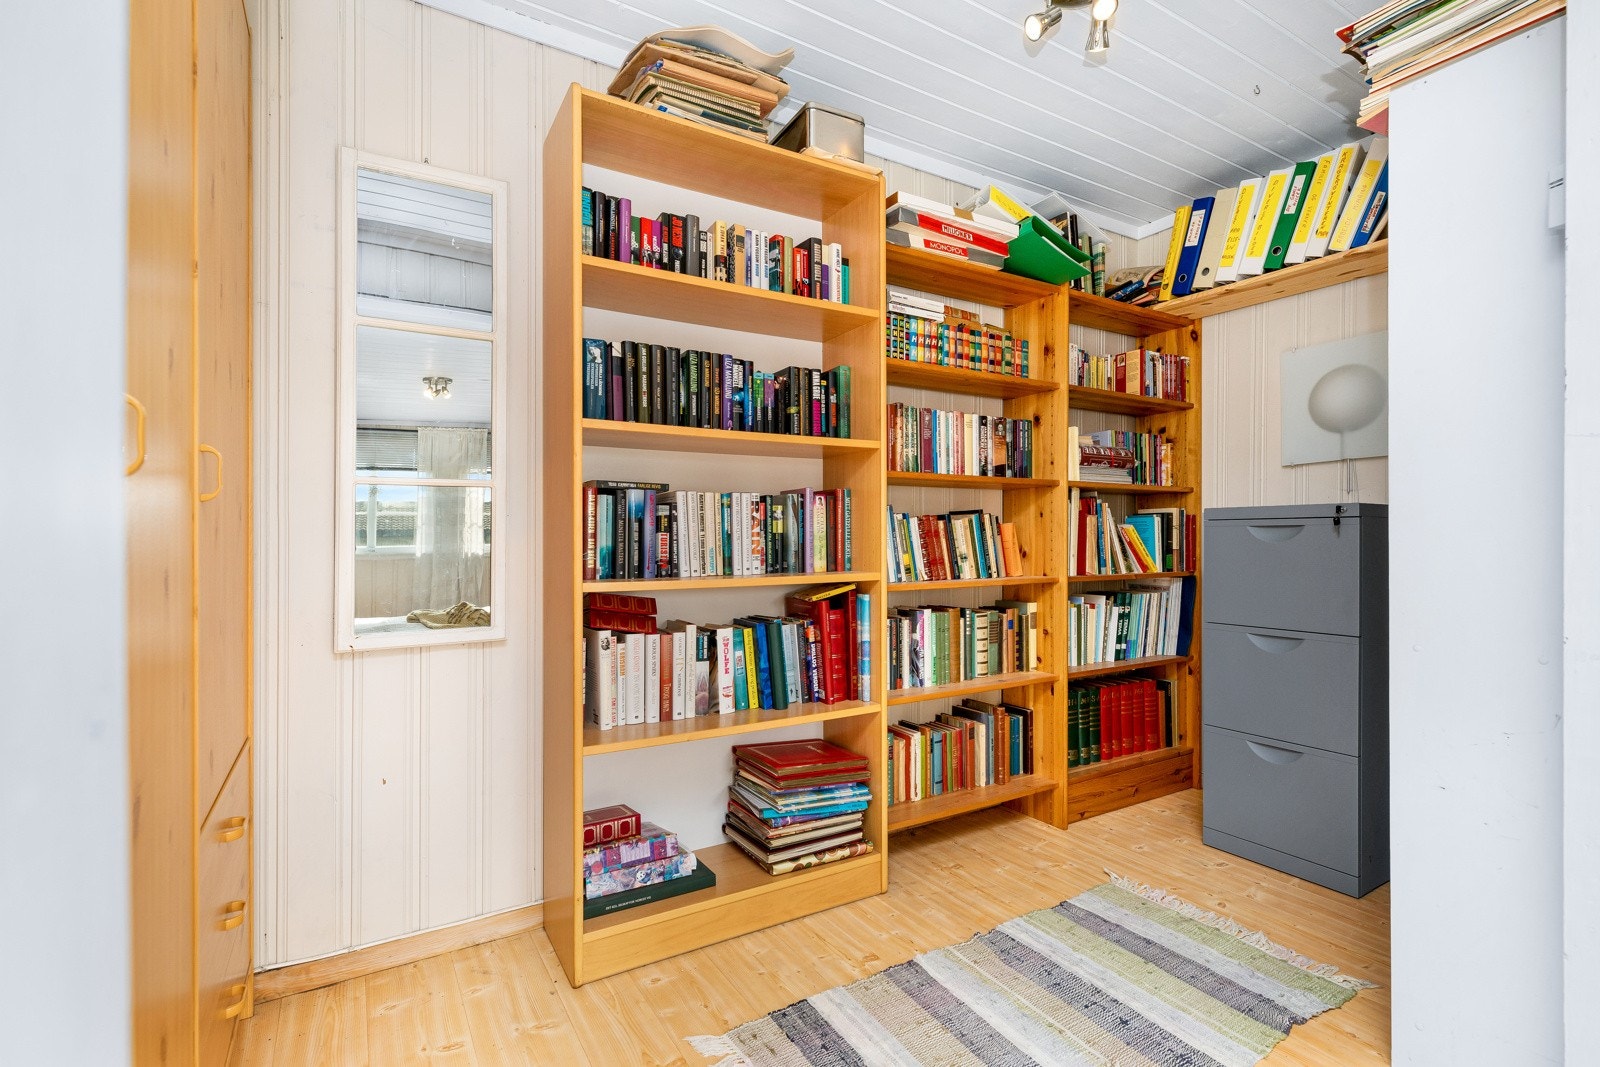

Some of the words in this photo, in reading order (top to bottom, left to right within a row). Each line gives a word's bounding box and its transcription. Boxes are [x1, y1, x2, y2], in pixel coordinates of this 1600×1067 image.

[672, 217, 682, 226] JO
[672, 226, 682, 248] NESBØ
[930, 241, 964, 255] MONOPOL
[752, 501, 760, 555] RAIN
